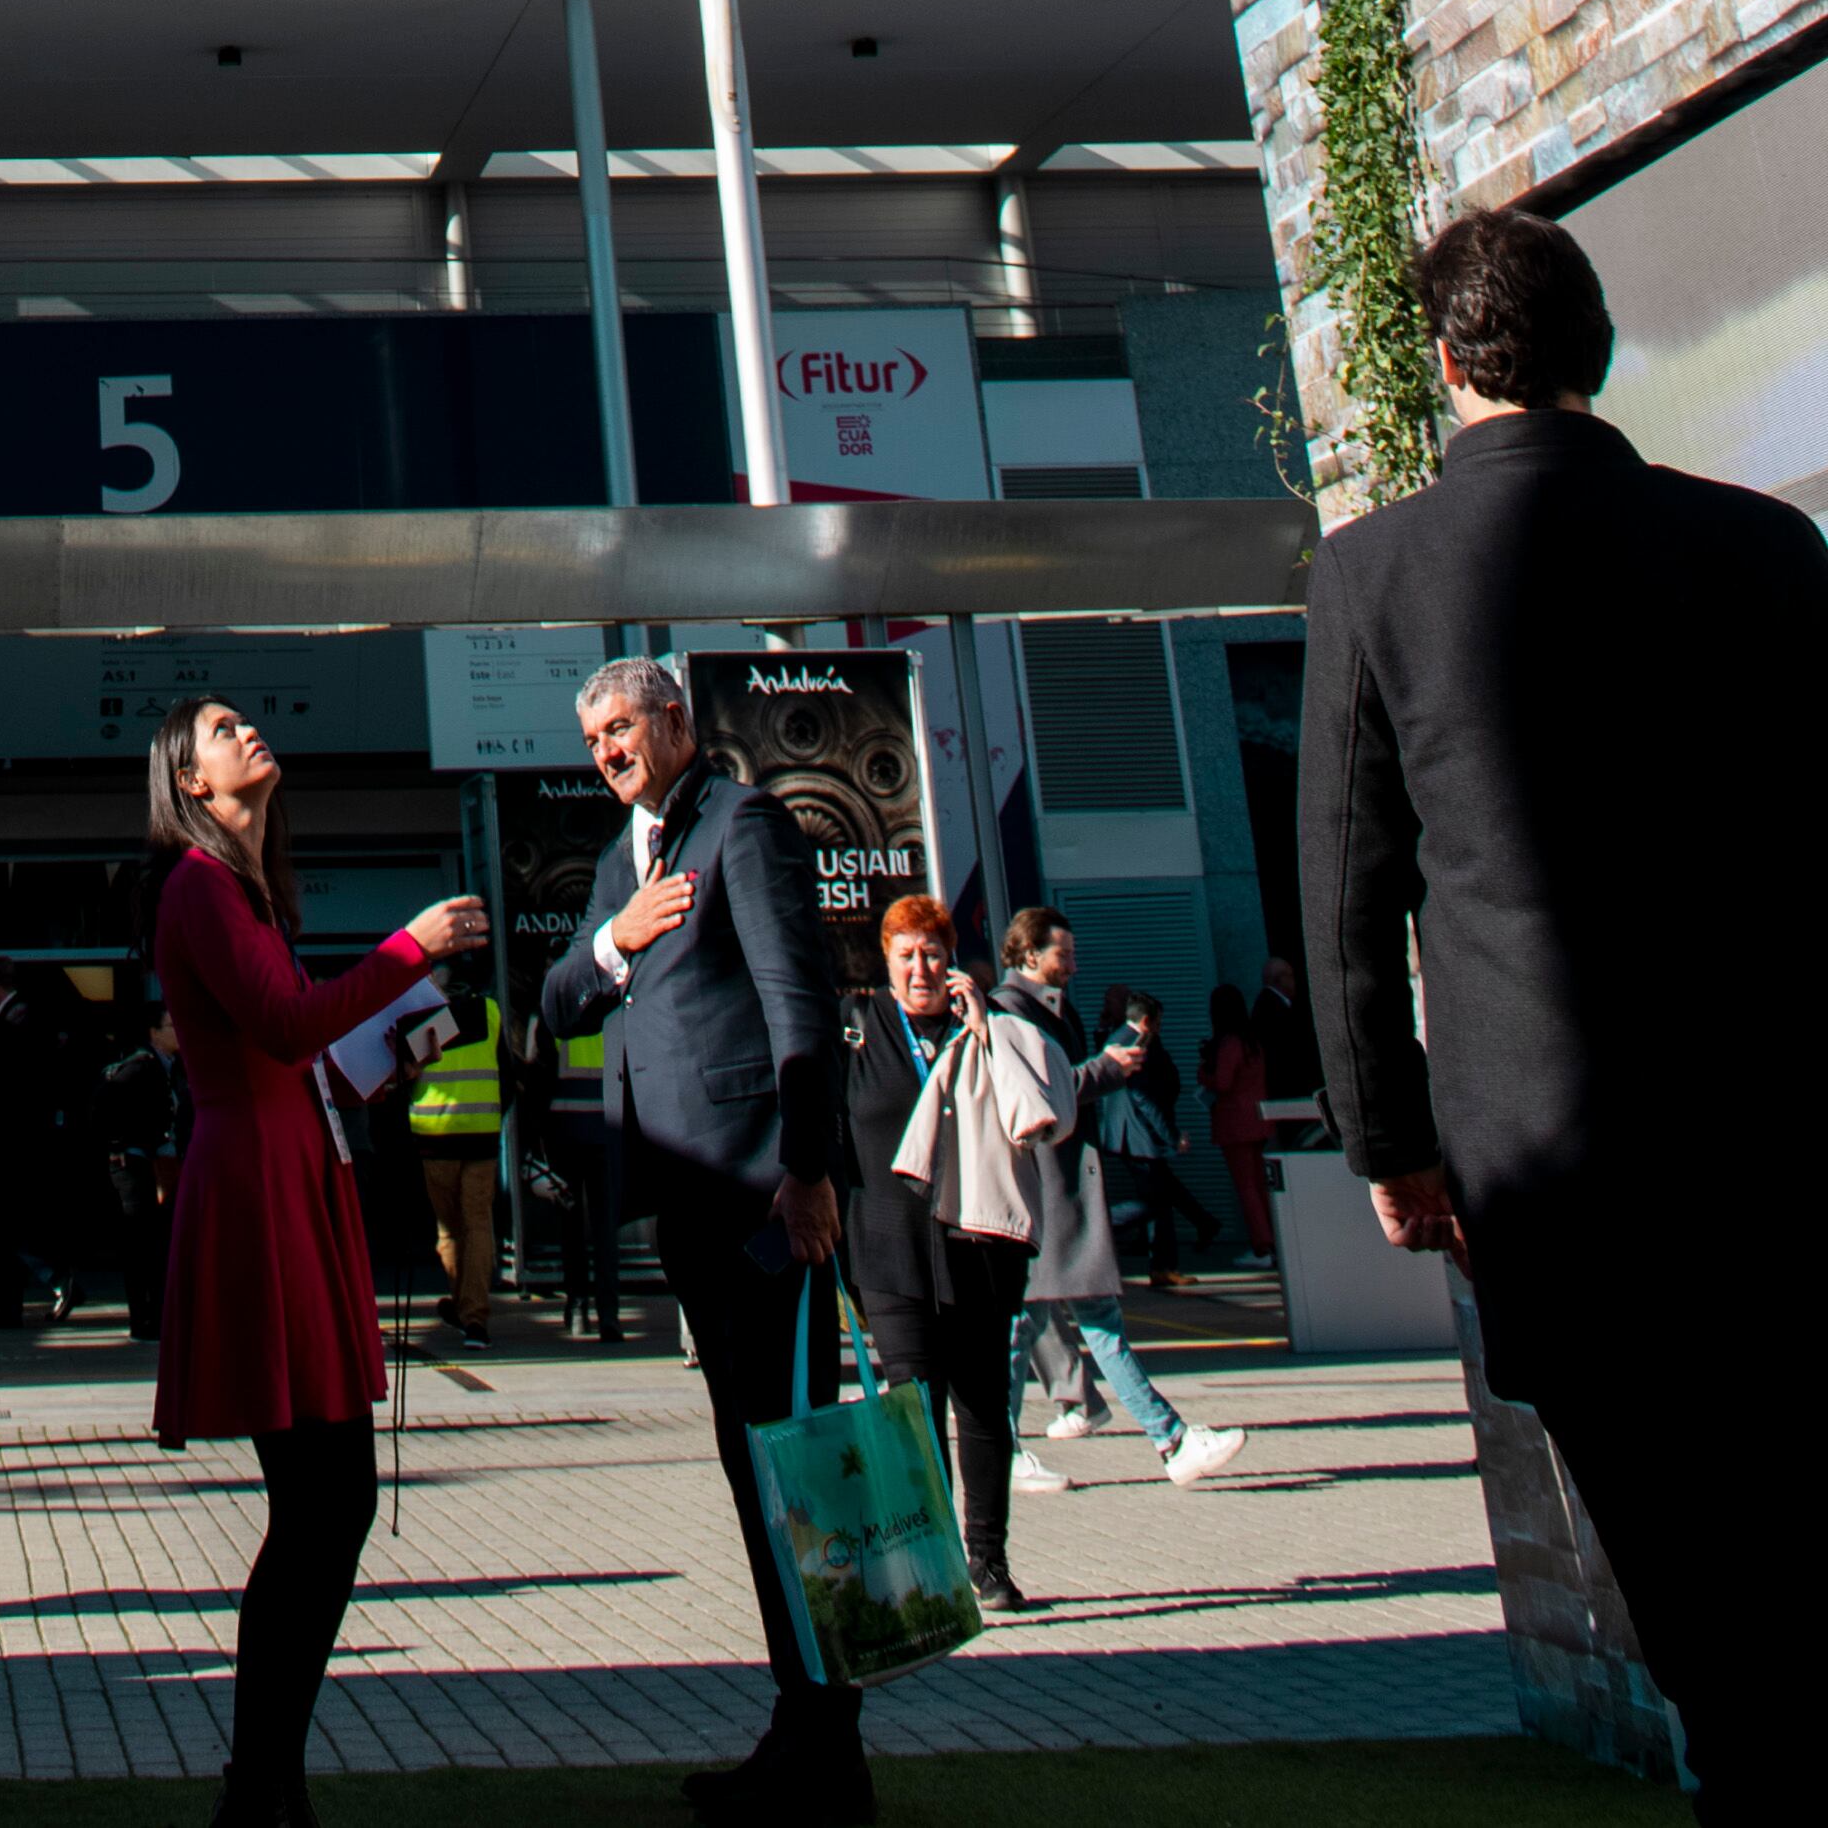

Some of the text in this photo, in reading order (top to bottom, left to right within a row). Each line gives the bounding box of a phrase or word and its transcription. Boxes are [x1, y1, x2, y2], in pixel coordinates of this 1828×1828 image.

[800, 351, 900, 395] Fitur
[98, 373, 182, 515] 5
[839, 442, 875, 456] DOR
[863, 1505, 931, 1548] Maldives
